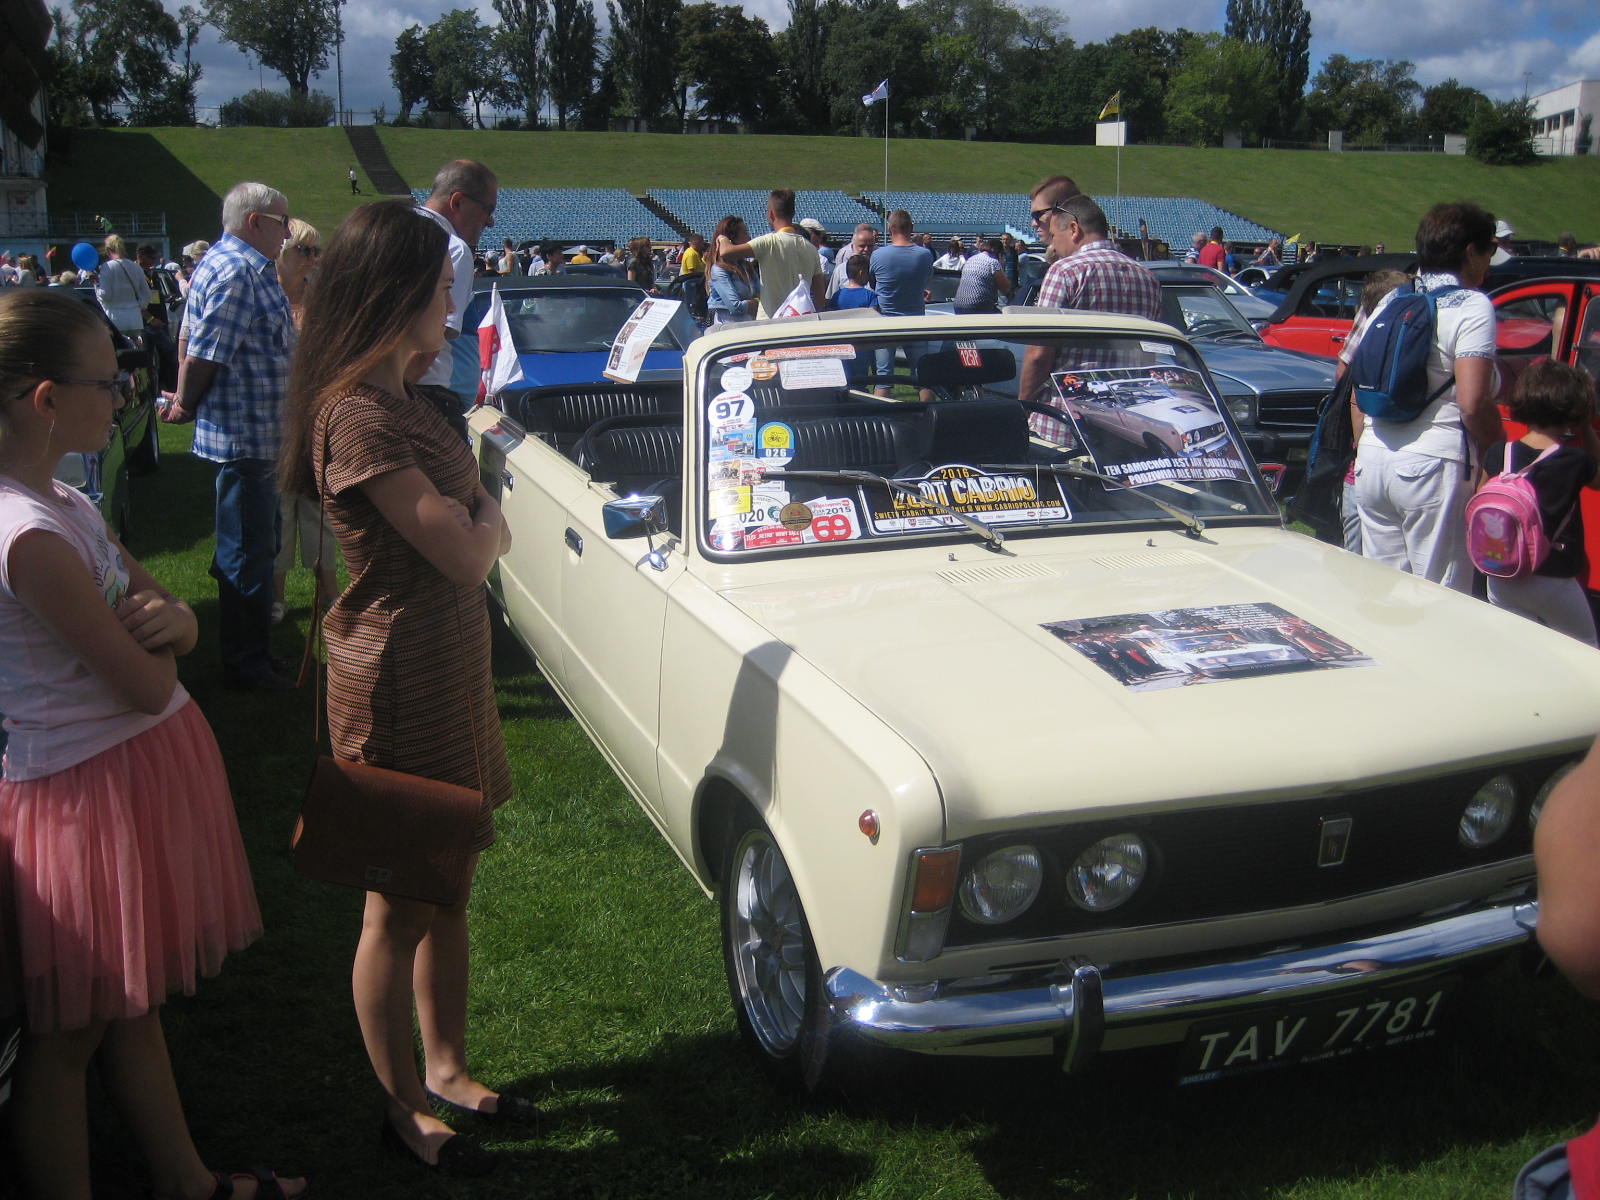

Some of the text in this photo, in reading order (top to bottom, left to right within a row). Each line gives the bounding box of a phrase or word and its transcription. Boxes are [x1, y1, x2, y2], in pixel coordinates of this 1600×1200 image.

[715, 399, 745, 419] 97
[765, 448, 787, 457] 026
[940, 468, 970, 480] 2016
[1103, 464, 1122, 476] TEN
[1120, 457, 1172, 474] SAMOCHÓD
[950, 476, 1037, 505] CABRIO
[825, 506, 852, 515] 2015
[811, 514, 852, 541] 69
[1199, 990, 1443, 1070] TAV 7781
